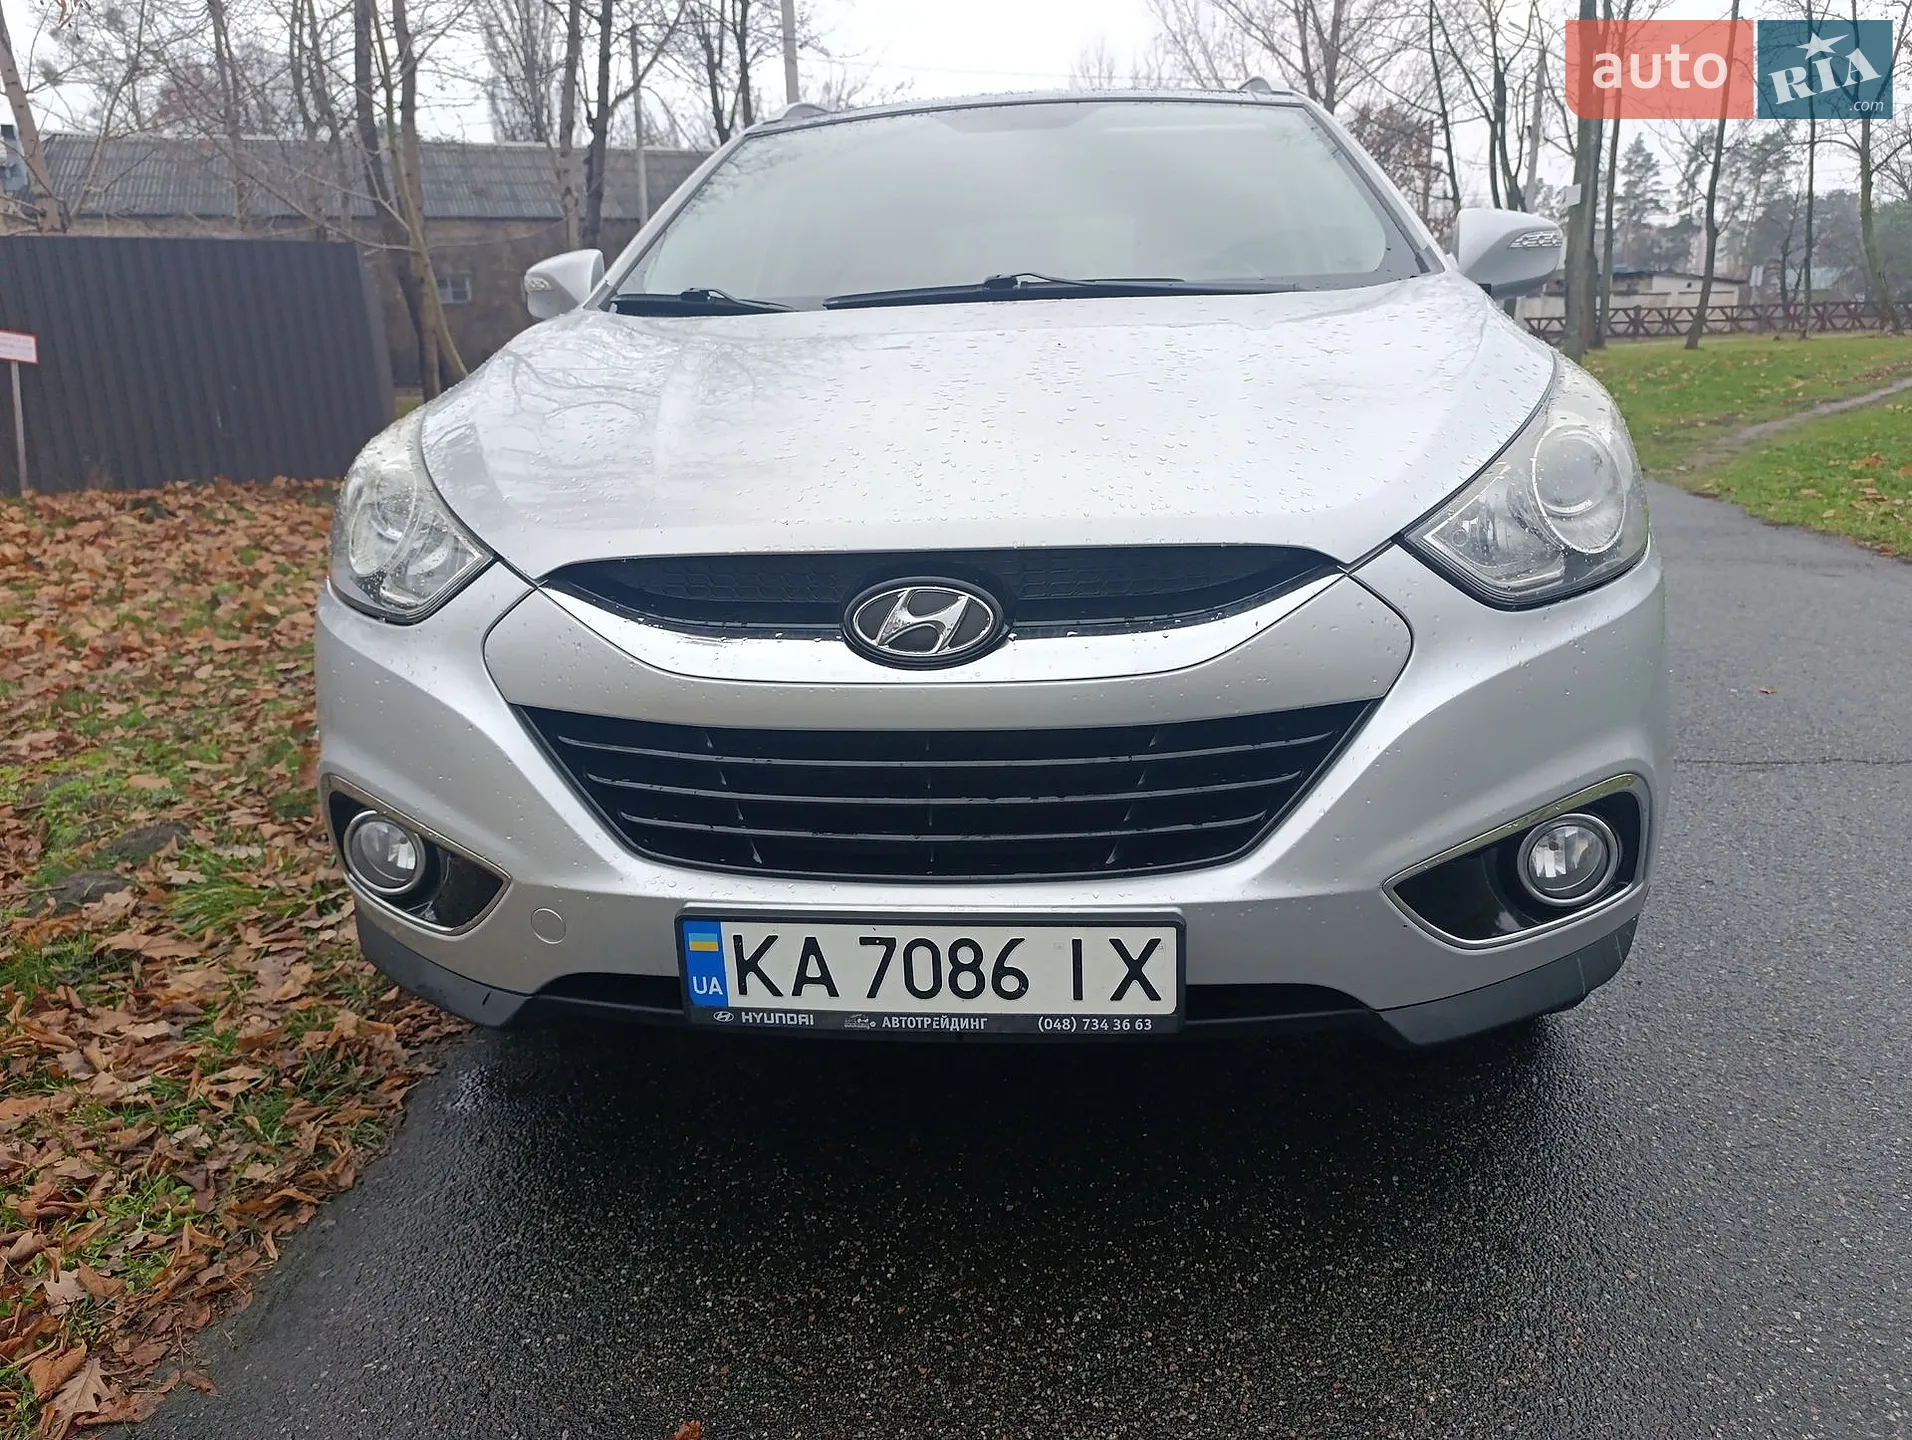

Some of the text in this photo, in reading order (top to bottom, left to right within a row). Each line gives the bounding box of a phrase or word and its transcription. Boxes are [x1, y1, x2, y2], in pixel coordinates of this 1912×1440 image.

[733, 934, 840, 998] KA
[858, 936, 1030, 1000] 7086
[692, 975, 724, 996] UA
[741, 1011, 814, 1026] HYUNDAI
[881, 1015, 988, 1031] АВТОТРЕЙДИНГ
[1038, 1016, 1153, 1032] (048) 734 36 63
